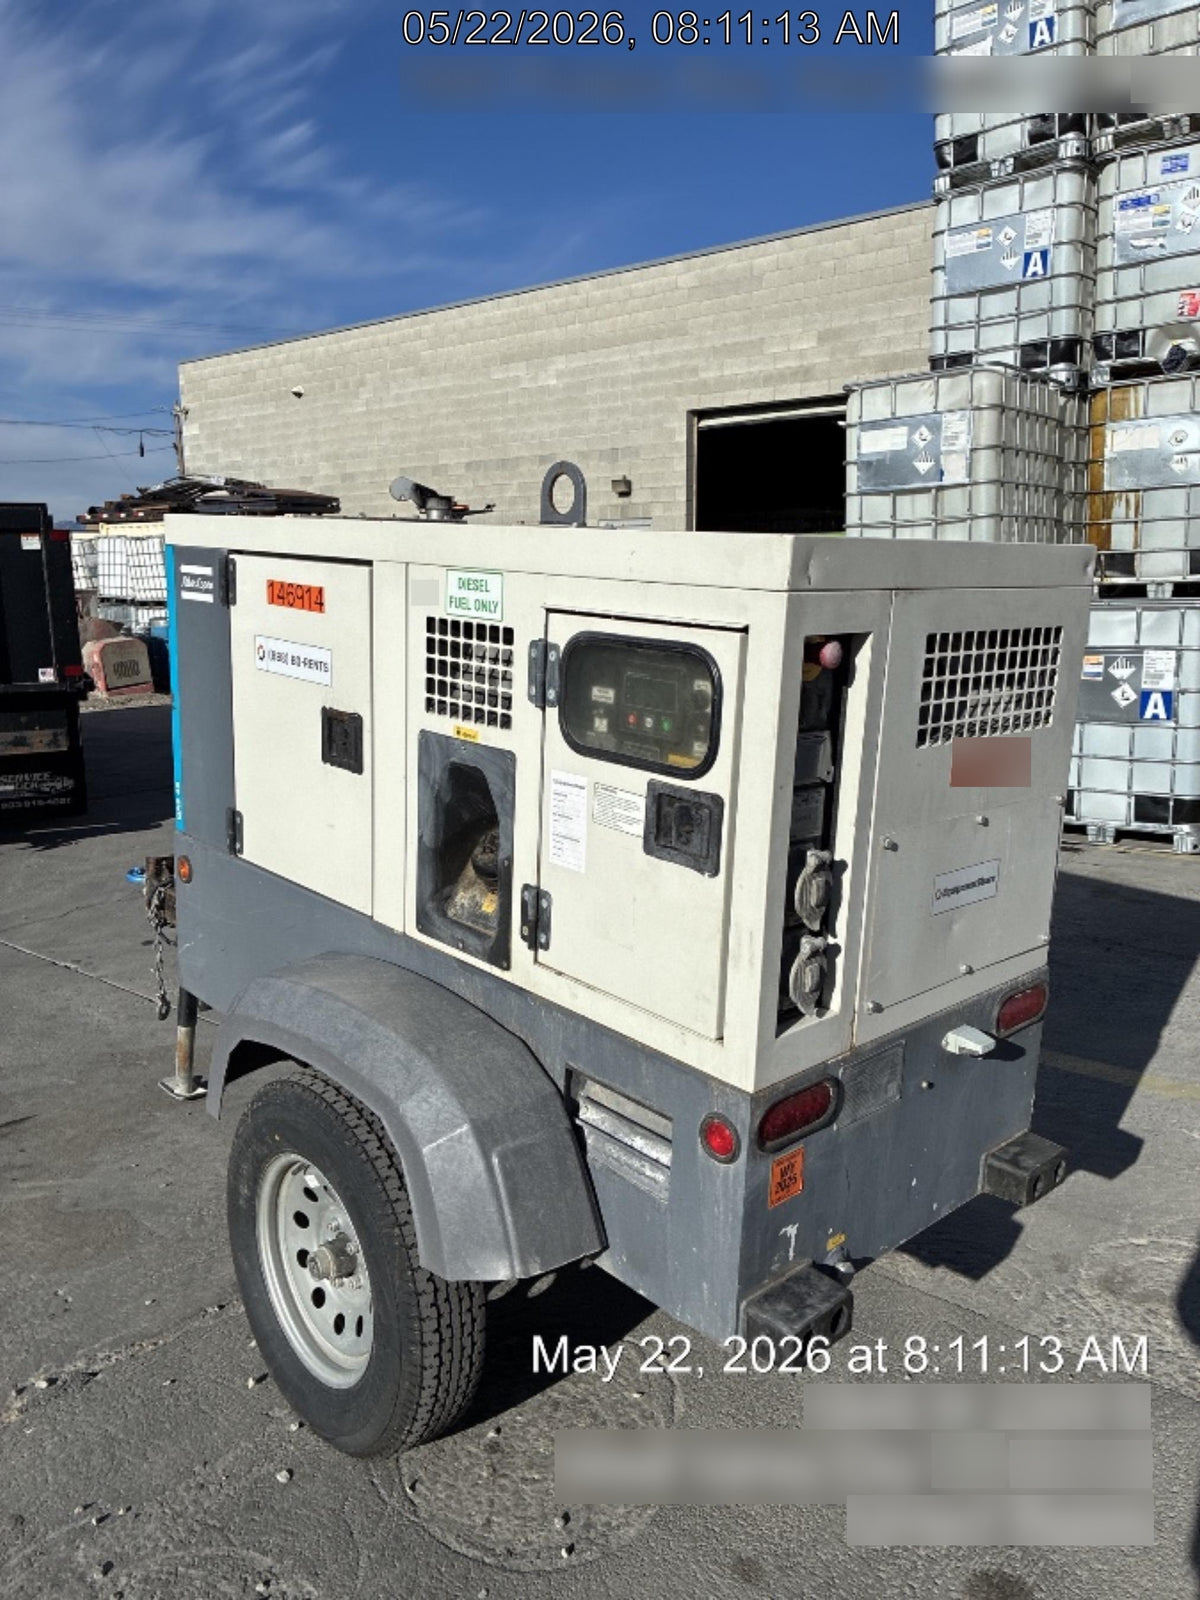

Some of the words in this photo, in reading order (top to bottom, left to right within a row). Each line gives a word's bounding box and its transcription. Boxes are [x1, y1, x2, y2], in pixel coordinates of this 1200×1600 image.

[1033, 20, 1052, 47] A
[1026, 251, 1044, 277] A
[267, 580, 324, 613] 146914
[458, 577, 490, 593] DIESEL
[449, 595, 471, 610] FUEL
[474, 598, 498, 614] ONLY
[1143, 692, 1167, 719] A
